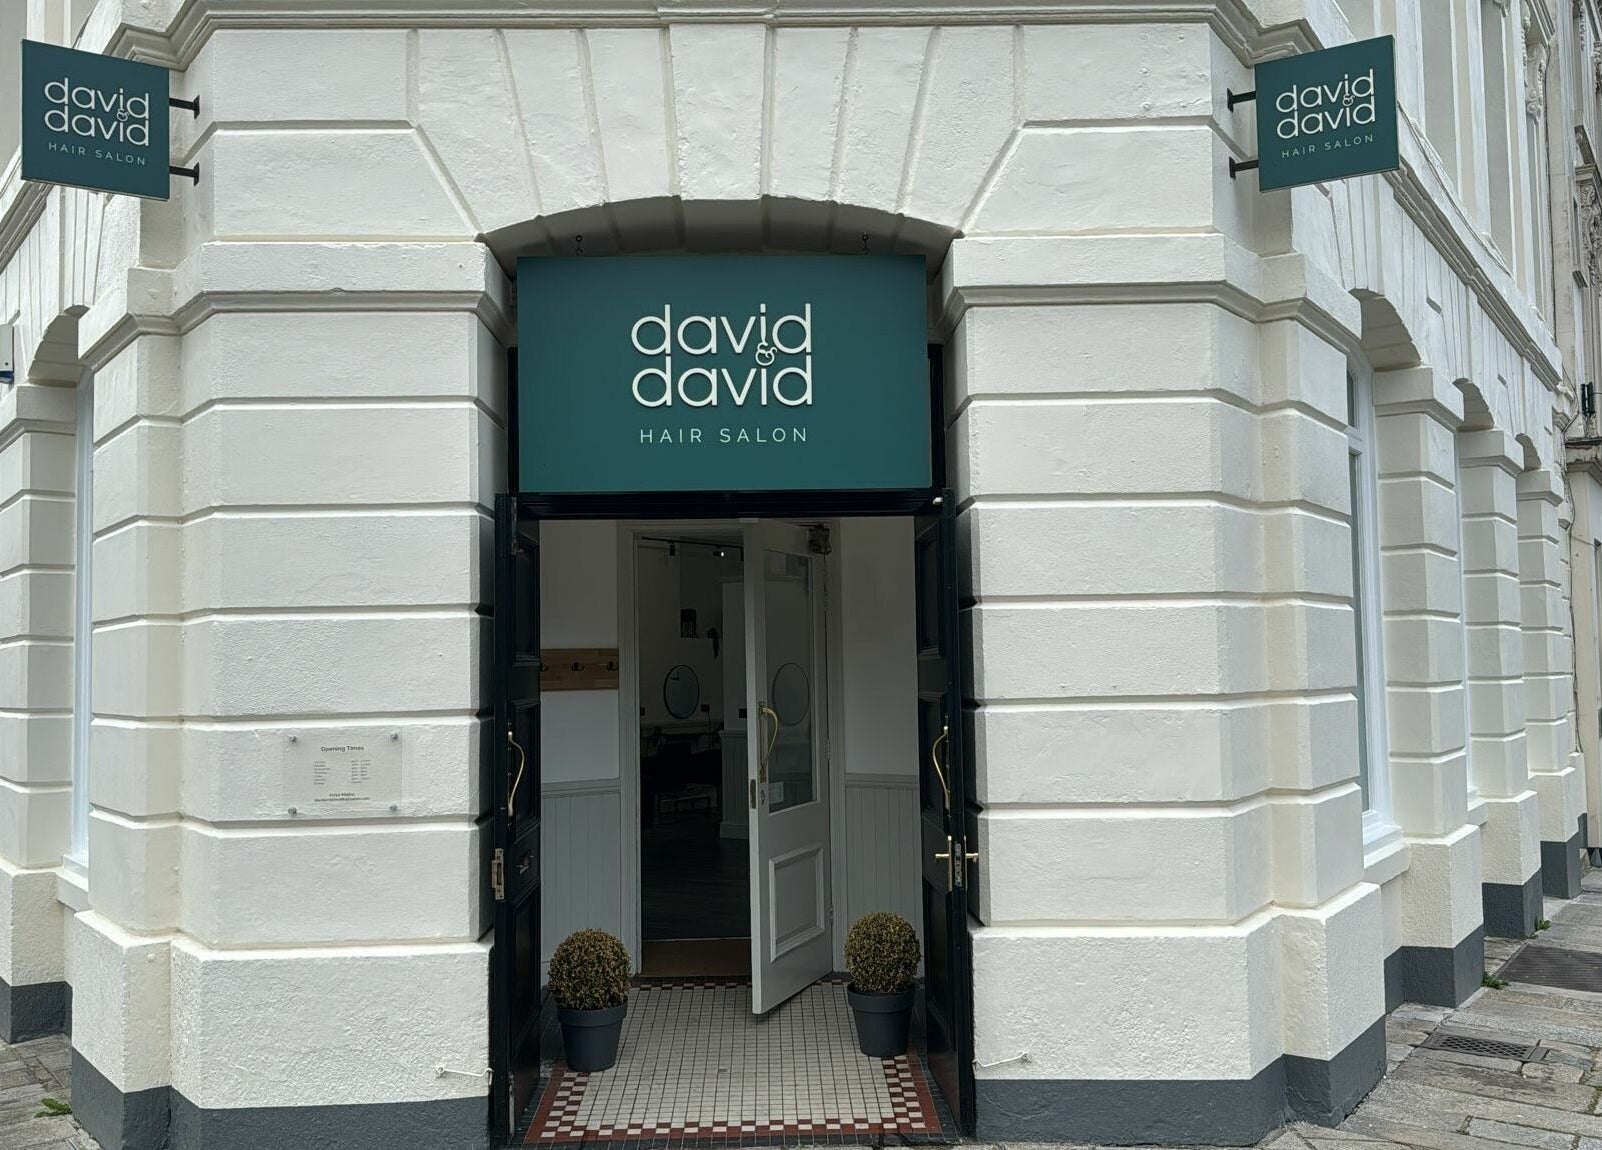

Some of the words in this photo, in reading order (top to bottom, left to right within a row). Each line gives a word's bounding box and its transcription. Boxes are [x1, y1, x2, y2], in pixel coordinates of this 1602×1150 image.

[44, 77, 149, 120] david
[1276, 68, 1374, 113] david
[44, 105, 149, 147] david
[1277, 96, 1376, 139] david
[48, 141, 86, 156] HAIR
[95, 149, 146, 166] SALON
[1281, 144, 1316, 159] HAIR
[1324, 134, 1373, 151] SALON
[631, 303, 812, 355] david
[755, 342, 777, 366] &
[632, 355, 813, 407] david
[640, 428, 702, 443] HAIR
[719, 427, 807, 443] SALON
